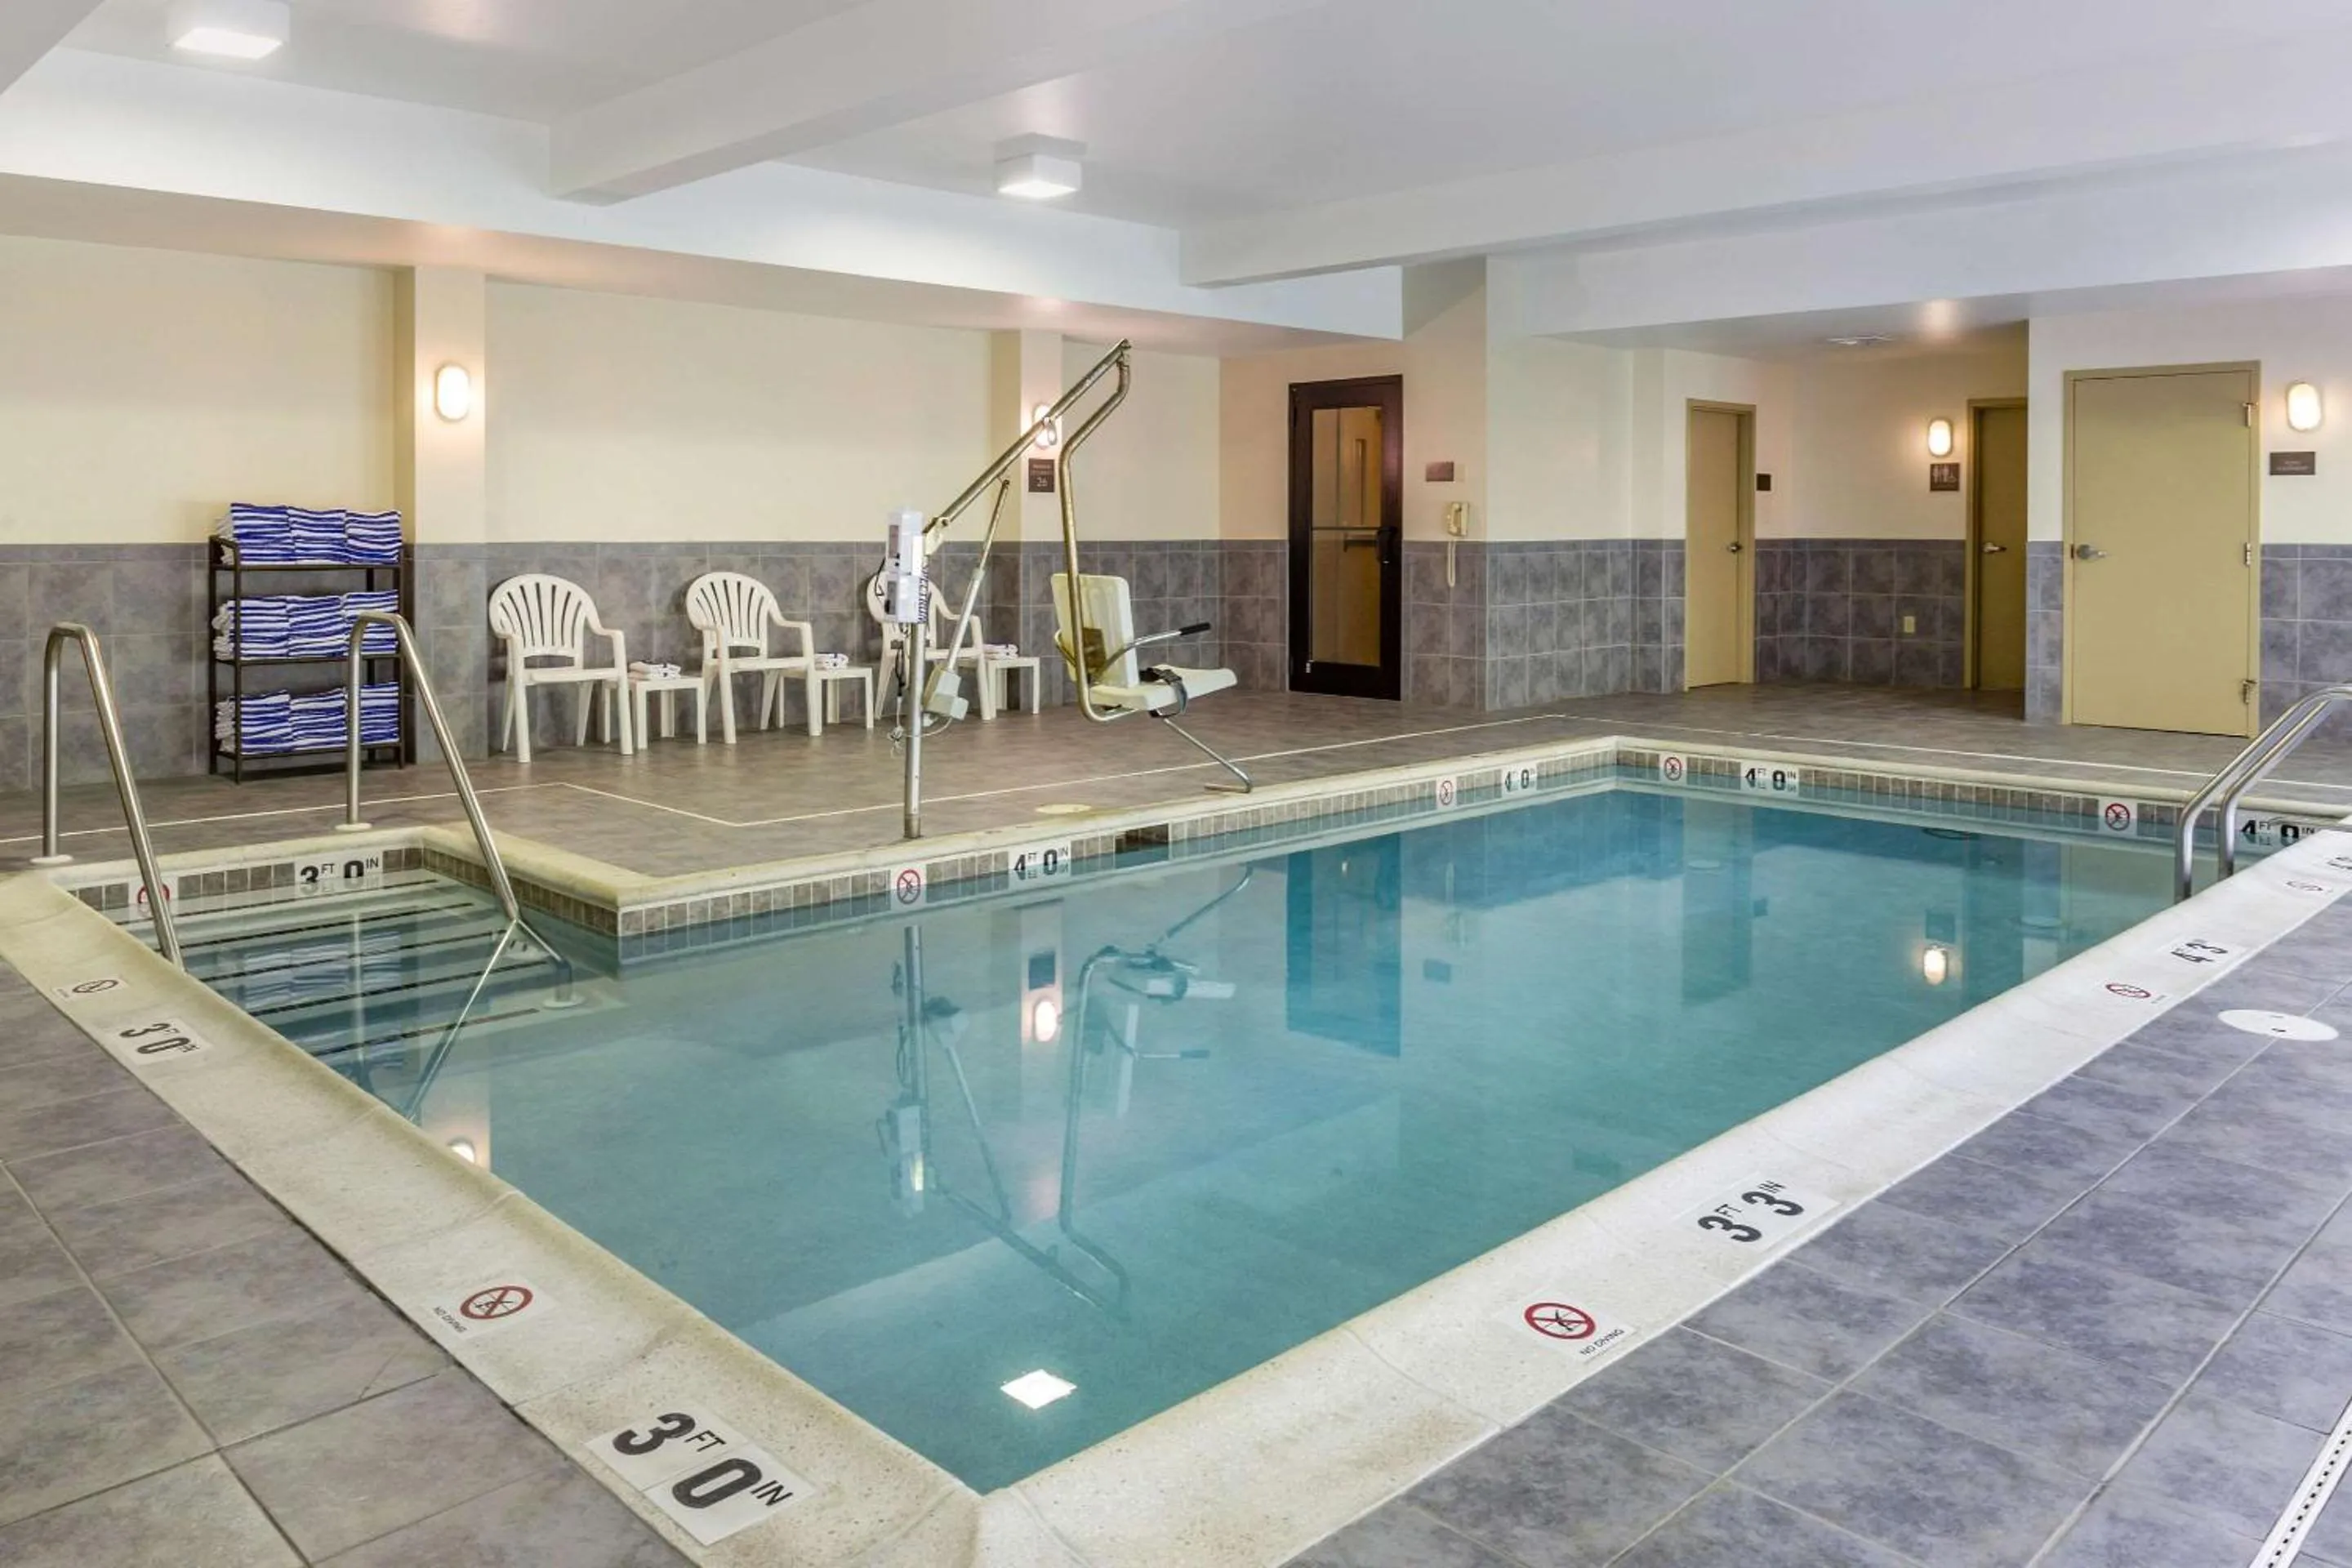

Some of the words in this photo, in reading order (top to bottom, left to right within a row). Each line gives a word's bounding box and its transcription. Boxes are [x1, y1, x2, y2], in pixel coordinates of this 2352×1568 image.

[300, 865, 319, 884] 3
[321, 862, 335, 875] FT
[366, 857, 379, 869] IN
[119, 1022, 171, 1038] 3
[136, 1037, 190, 1054] 0
[1713, 1204, 1743, 1218] FT
[1741, 1191, 1804, 1216] 3
[1697, 1215, 1762, 1242] 3
[612, 1412, 696, 1456] 3
[684, 1430, 727, 1453] FT
[672, 1458, 763, 1509] 0
[750, 1480, 794, 1508] IN
